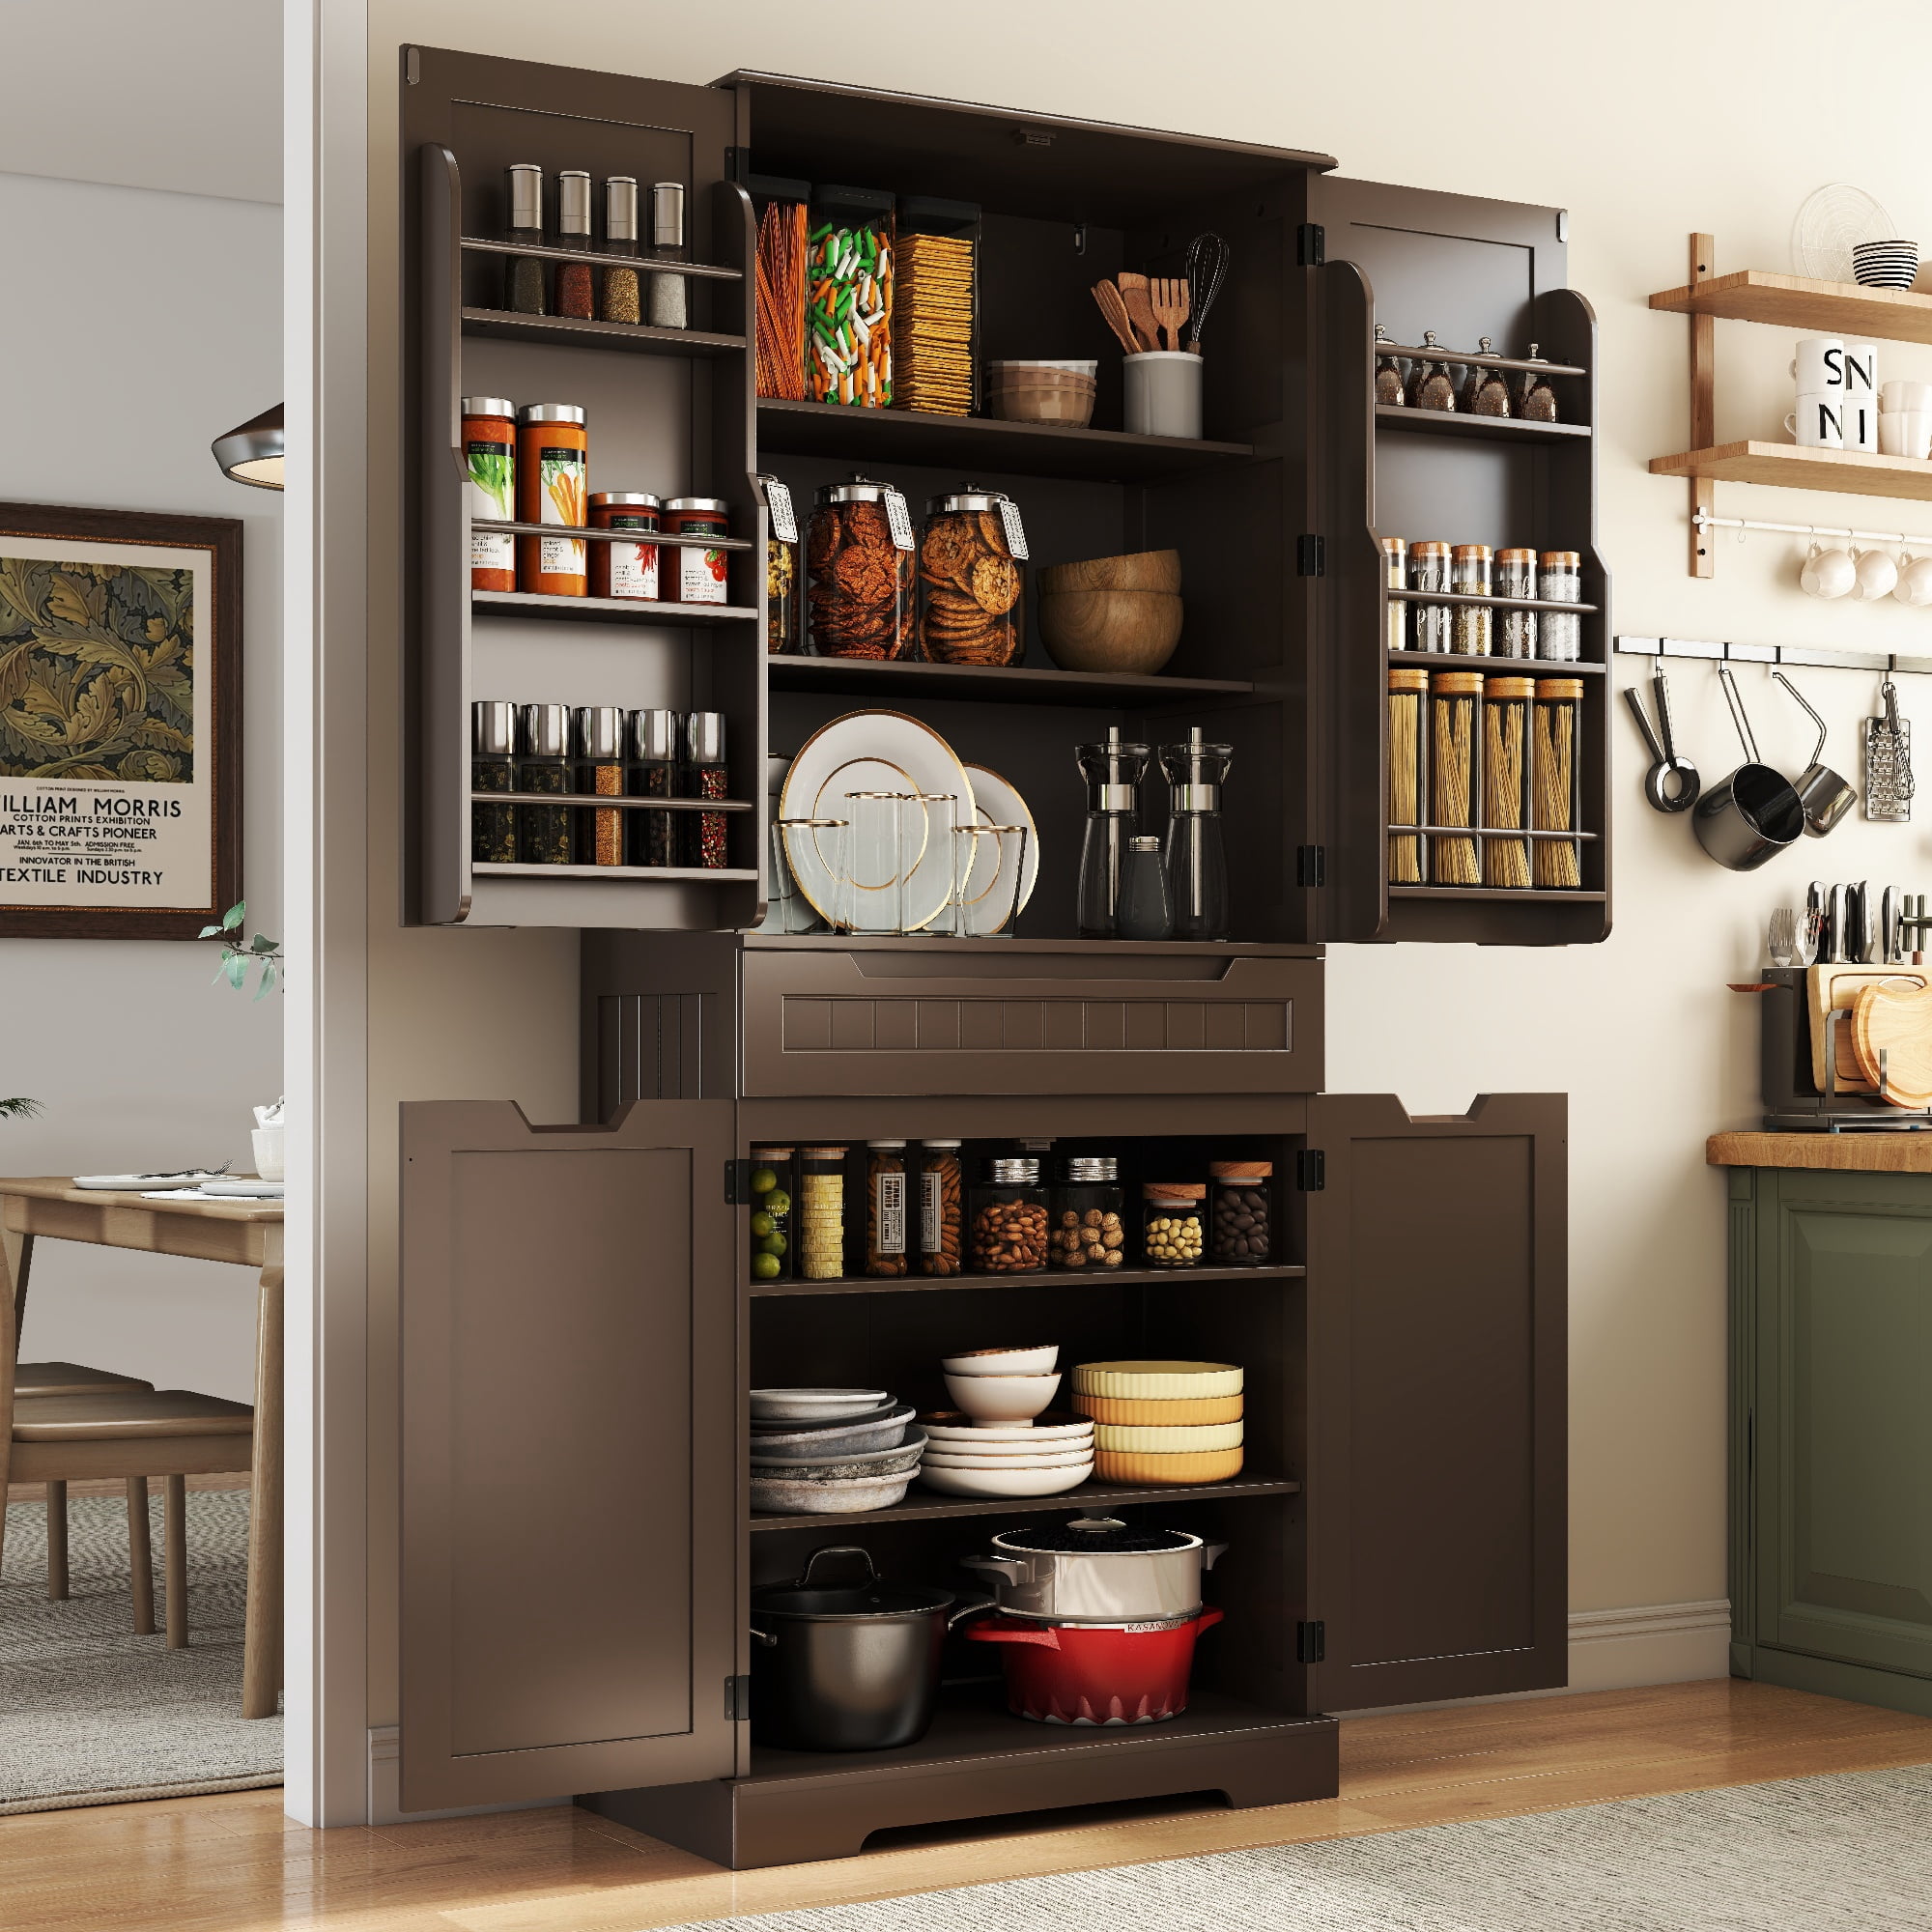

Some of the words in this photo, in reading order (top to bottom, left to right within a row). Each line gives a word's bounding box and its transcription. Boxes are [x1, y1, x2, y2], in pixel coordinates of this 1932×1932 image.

[0, 795, 77, 813] ILLIAM
[94, 797, 182, 817] MORRIS
[13, 813, 56, 822] COTTON
[59, 815, 94, 824] PRINTS
[96, 816, 151, 826] EXHIBITION
[0, 824, 34, 836] ARTS
[37, 825, 45, 837] &
[48, 825, 99, 838] CRAFTS
[102, 827, 157, 839] PIONEER
[19, 857, 71, 866] INNOVATOR
[85, 858, 101, 867] THE
[0, 867, 67, 882] TEXTILE
[77, 869, 163, 885] INDUSTRY
[1127, 1620, 1180, 1632] KASANOVA
